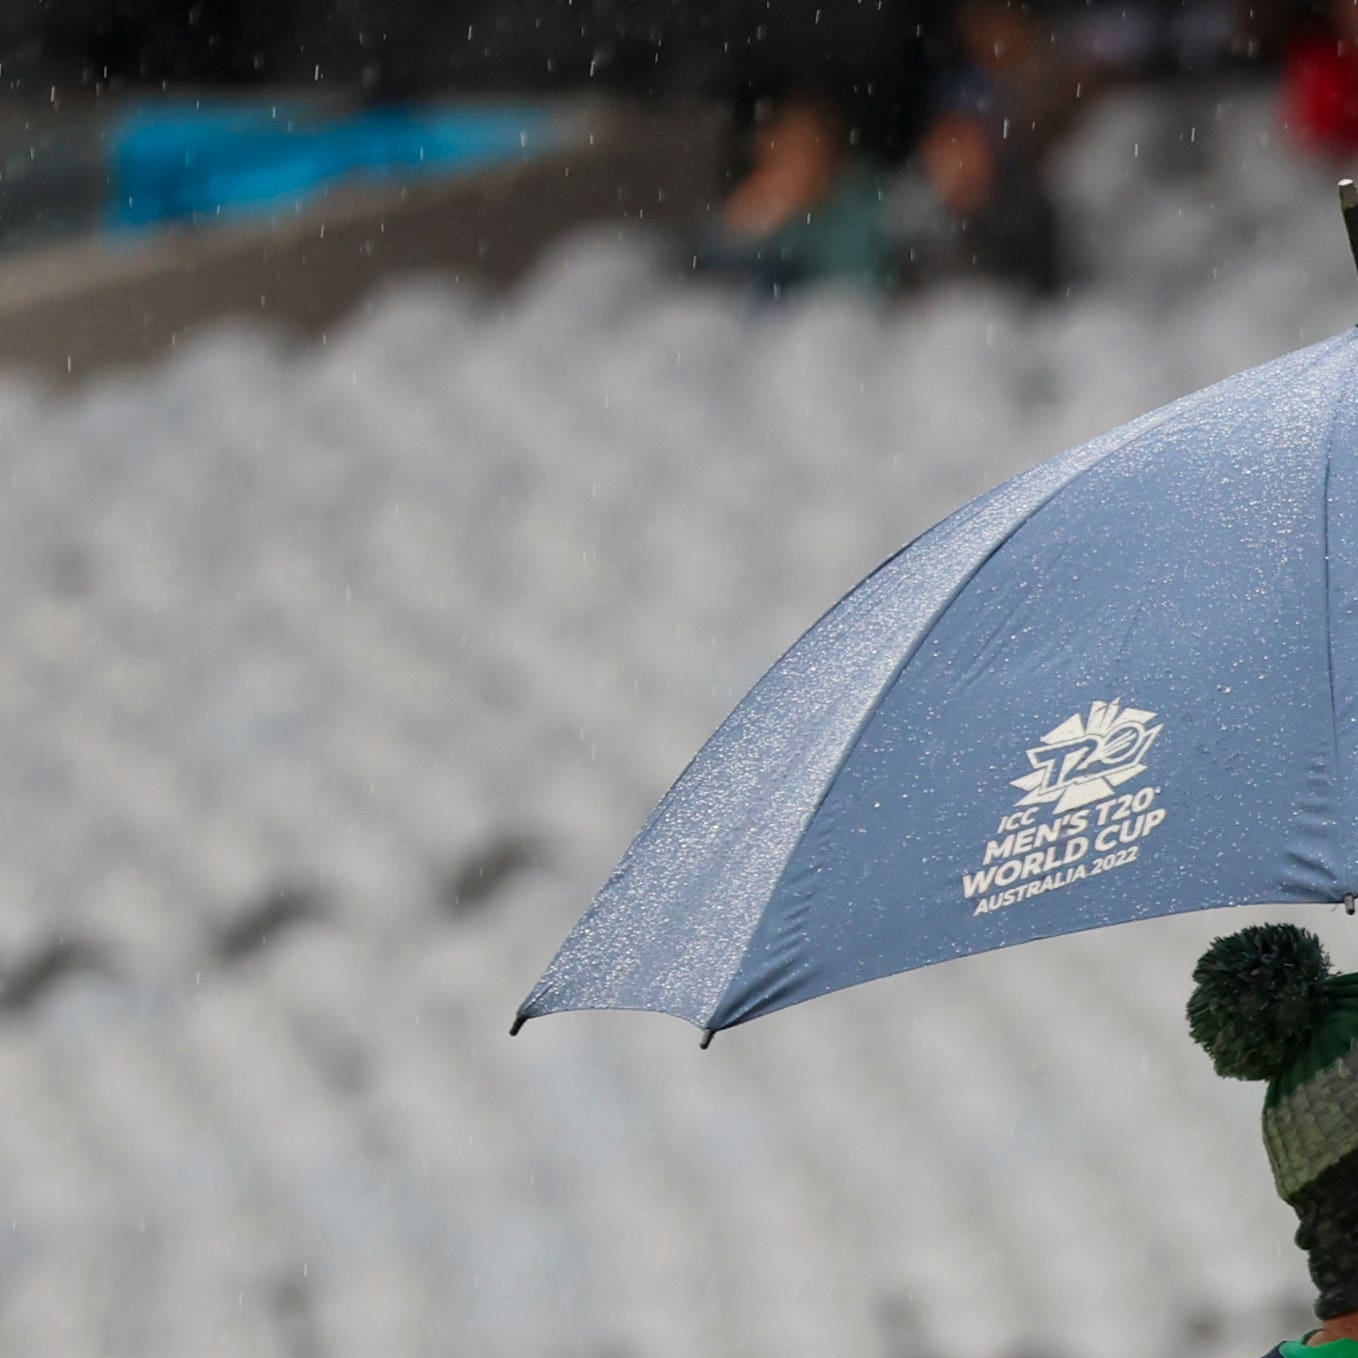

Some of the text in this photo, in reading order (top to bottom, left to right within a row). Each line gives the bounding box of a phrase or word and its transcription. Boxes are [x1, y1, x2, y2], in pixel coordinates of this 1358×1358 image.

[962, 808, 1167, 898] WORLD CUP
[982, 786, 1154, 866] MEN'S T20
[997, 807, 1039, 834] ICC
[973, 846, 1139, 916] AUSTRALIA 2022
